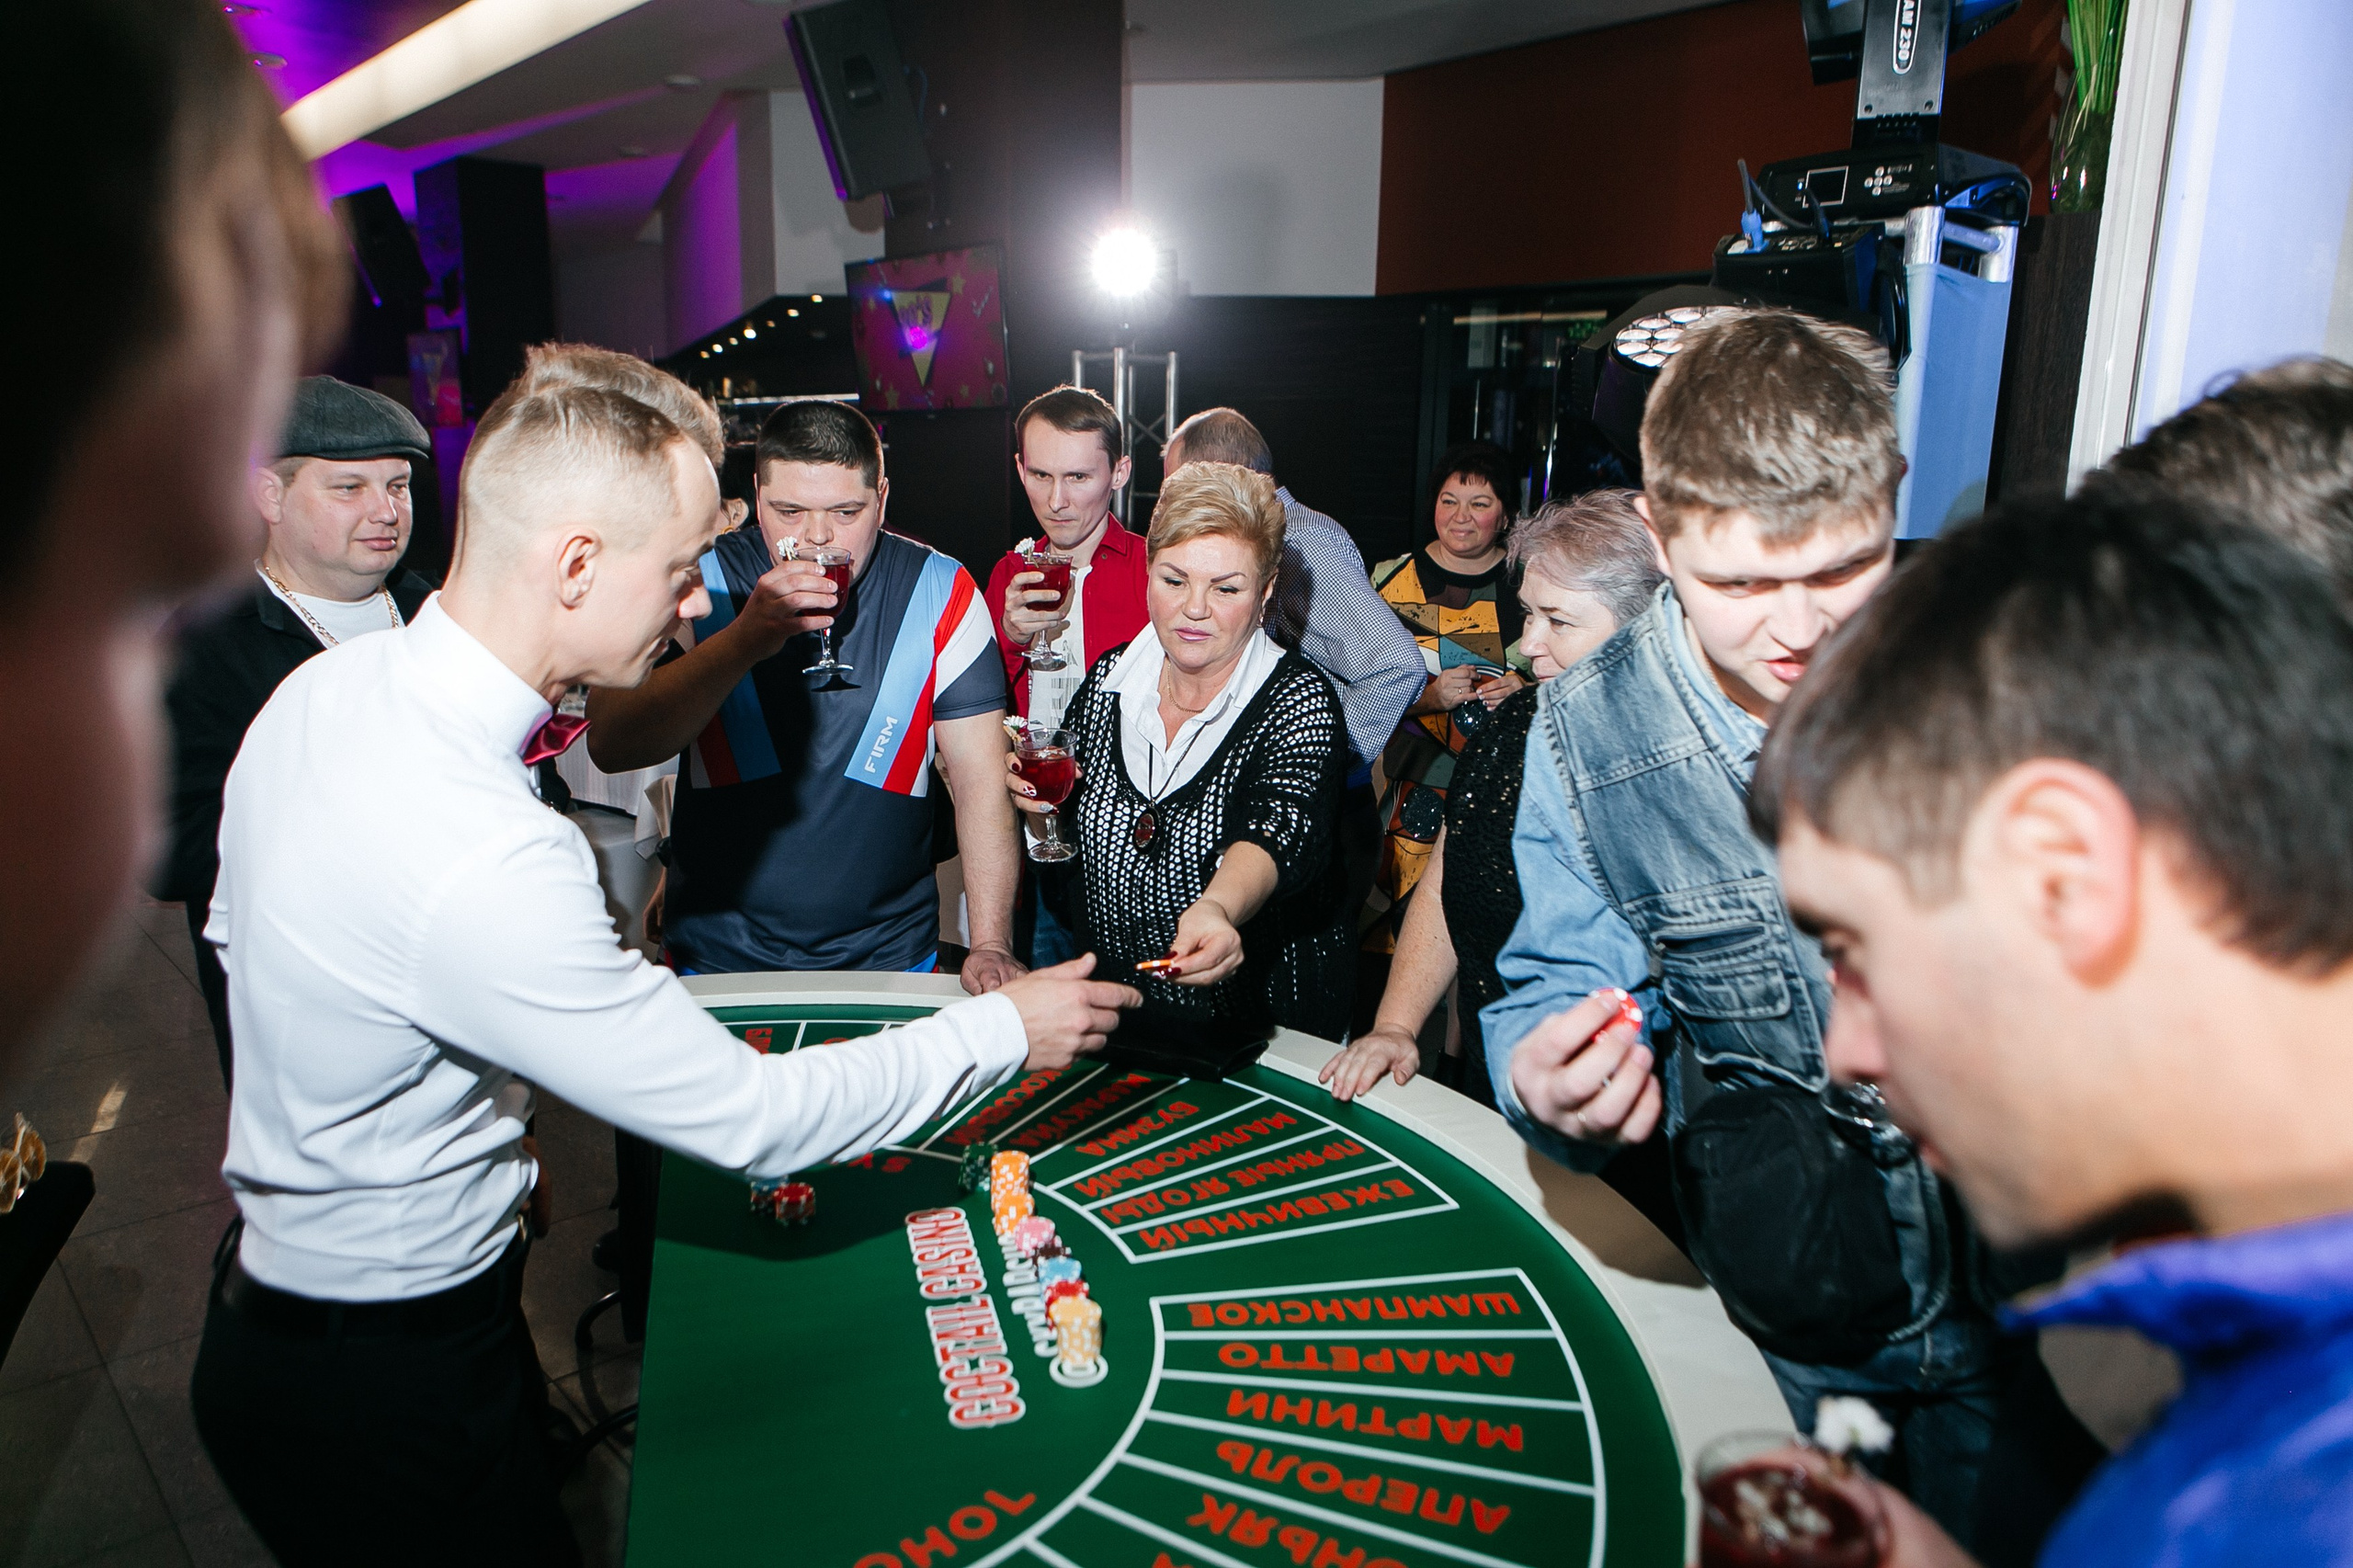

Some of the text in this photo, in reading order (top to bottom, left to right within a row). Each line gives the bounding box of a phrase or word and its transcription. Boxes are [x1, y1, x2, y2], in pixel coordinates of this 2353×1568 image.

[1898, 27, 1912, 62] 230
[864, 716, 898, 773] FIRM
[1074, 1112, 1298, 1199] МАЛИНОВЫЙ
[1075, 1100, 1199, 1156] БУЗИНА
[1100, 1139, 1365, 1224] ПРЯНЫЕ ЯГОДЫ
[1139, 1178, 1415, 1251] ЕЖЕВИЧНЫЙ
[904, 1206, 1027, 1429] COCTAIL CASINO
[1187, 1292, 1521, 1327] ШАМПАНСКОЕ
[1218, 1342, 1516, 1378] АМАРЕТТО
[1226, 1389, 1524, 1452] МАРТИНИ
[1216, 1440, 1511, 1535] АПЕРОЛЬ
[1186, 1494, 1408, 1568] НЬЯК
